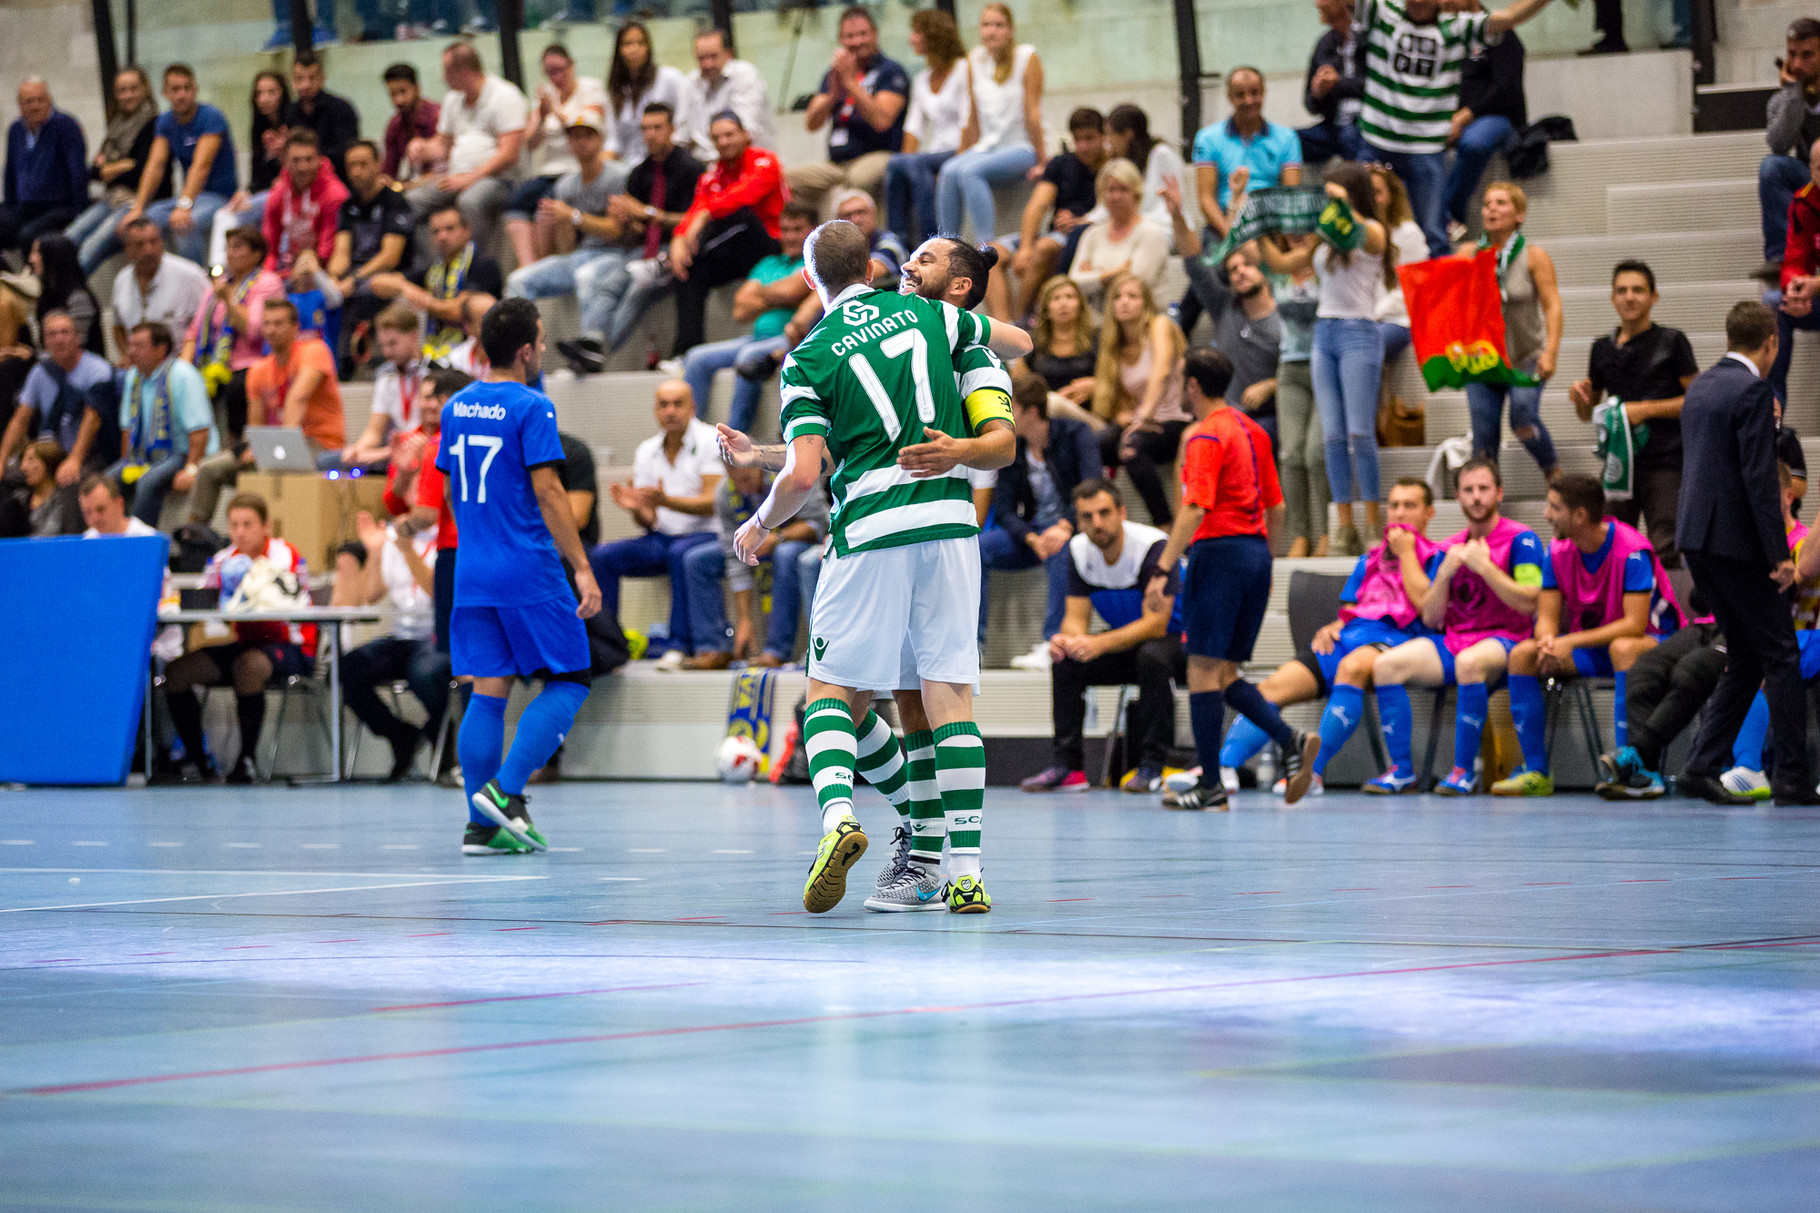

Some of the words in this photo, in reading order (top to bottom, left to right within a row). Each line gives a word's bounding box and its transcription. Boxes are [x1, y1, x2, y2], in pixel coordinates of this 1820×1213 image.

[831, 309, 919, 357] CAVINATO
[453, 401, 507, 421] Machado
[848, 327, 936, 442] 17
[448, 433, 503, 504] 17
